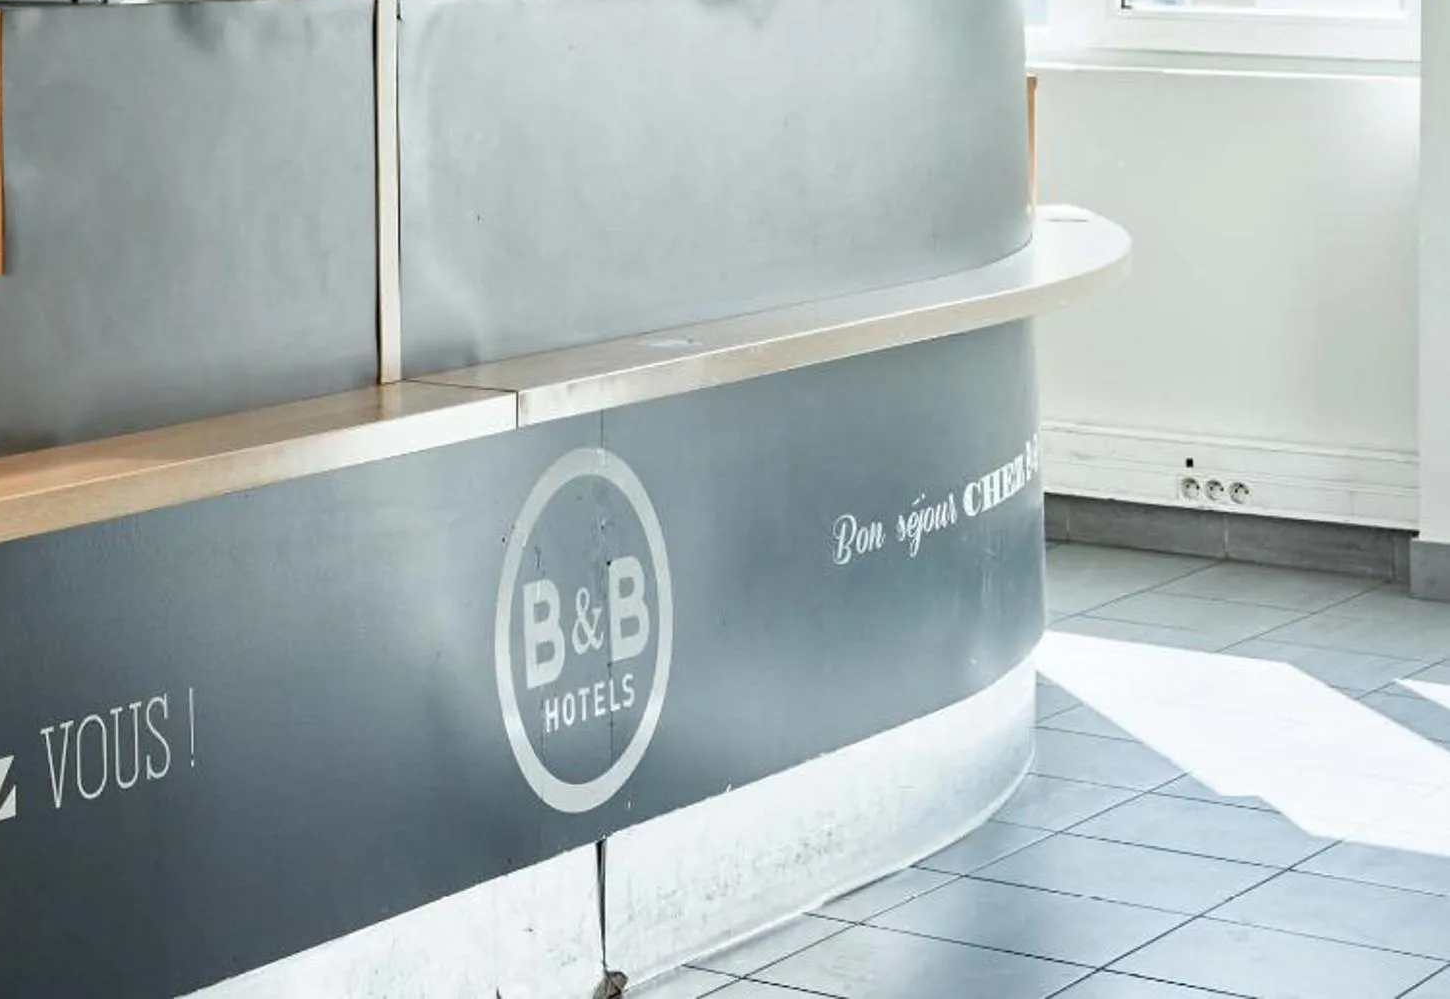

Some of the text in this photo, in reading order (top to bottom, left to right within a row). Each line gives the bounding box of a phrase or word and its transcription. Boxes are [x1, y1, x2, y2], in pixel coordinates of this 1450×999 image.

[833, 513, 886, 566] Bon
[963, 453, 1026, 517] CHEZ
[522, 555, 650, 690] B&B
[545, 673, 636, 733] HOTELS
